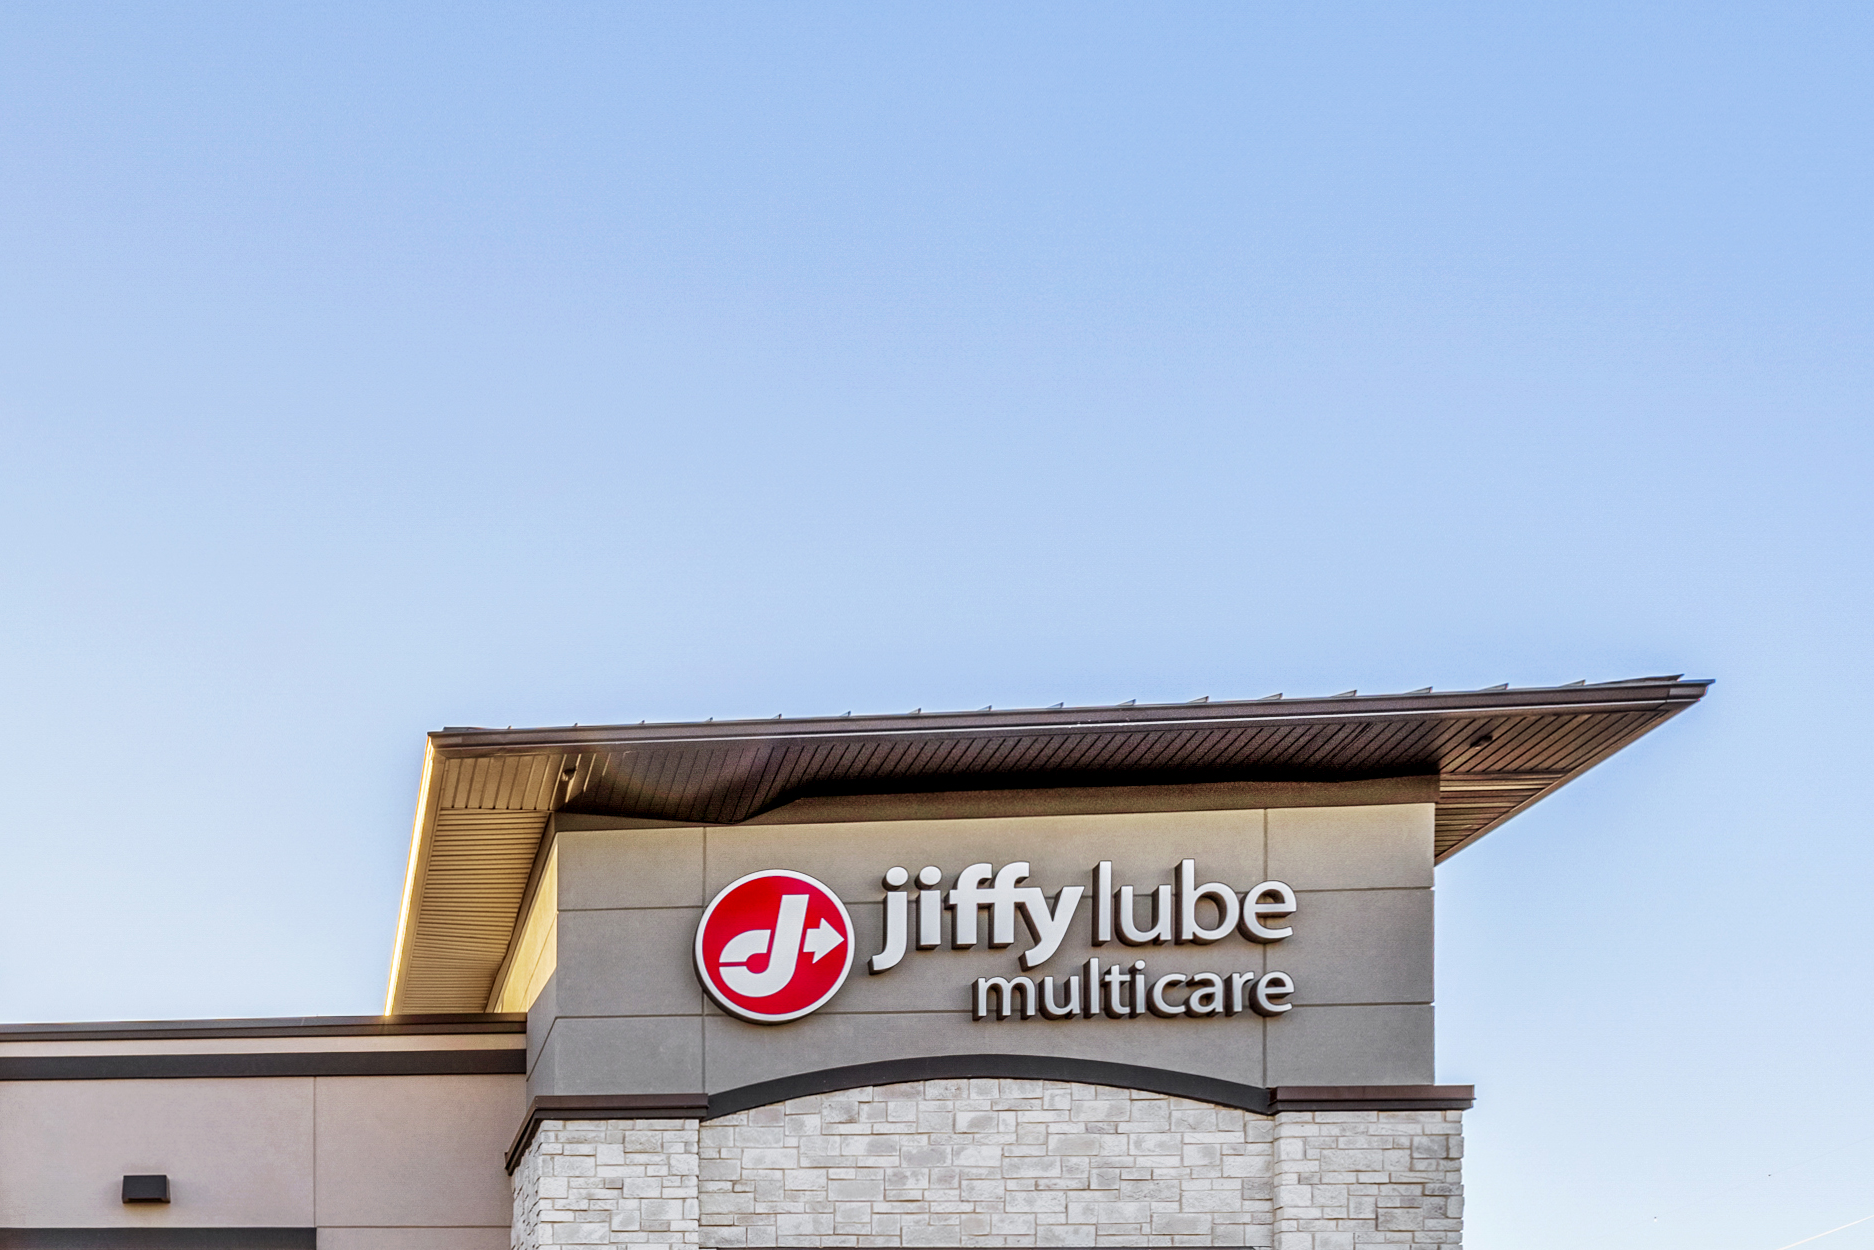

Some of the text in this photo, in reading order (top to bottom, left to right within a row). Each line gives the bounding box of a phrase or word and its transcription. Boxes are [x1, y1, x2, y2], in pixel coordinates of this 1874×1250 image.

[870, 859, 1297, 970] jiffy lube
[976, 957, 1296, 1018] multicare
